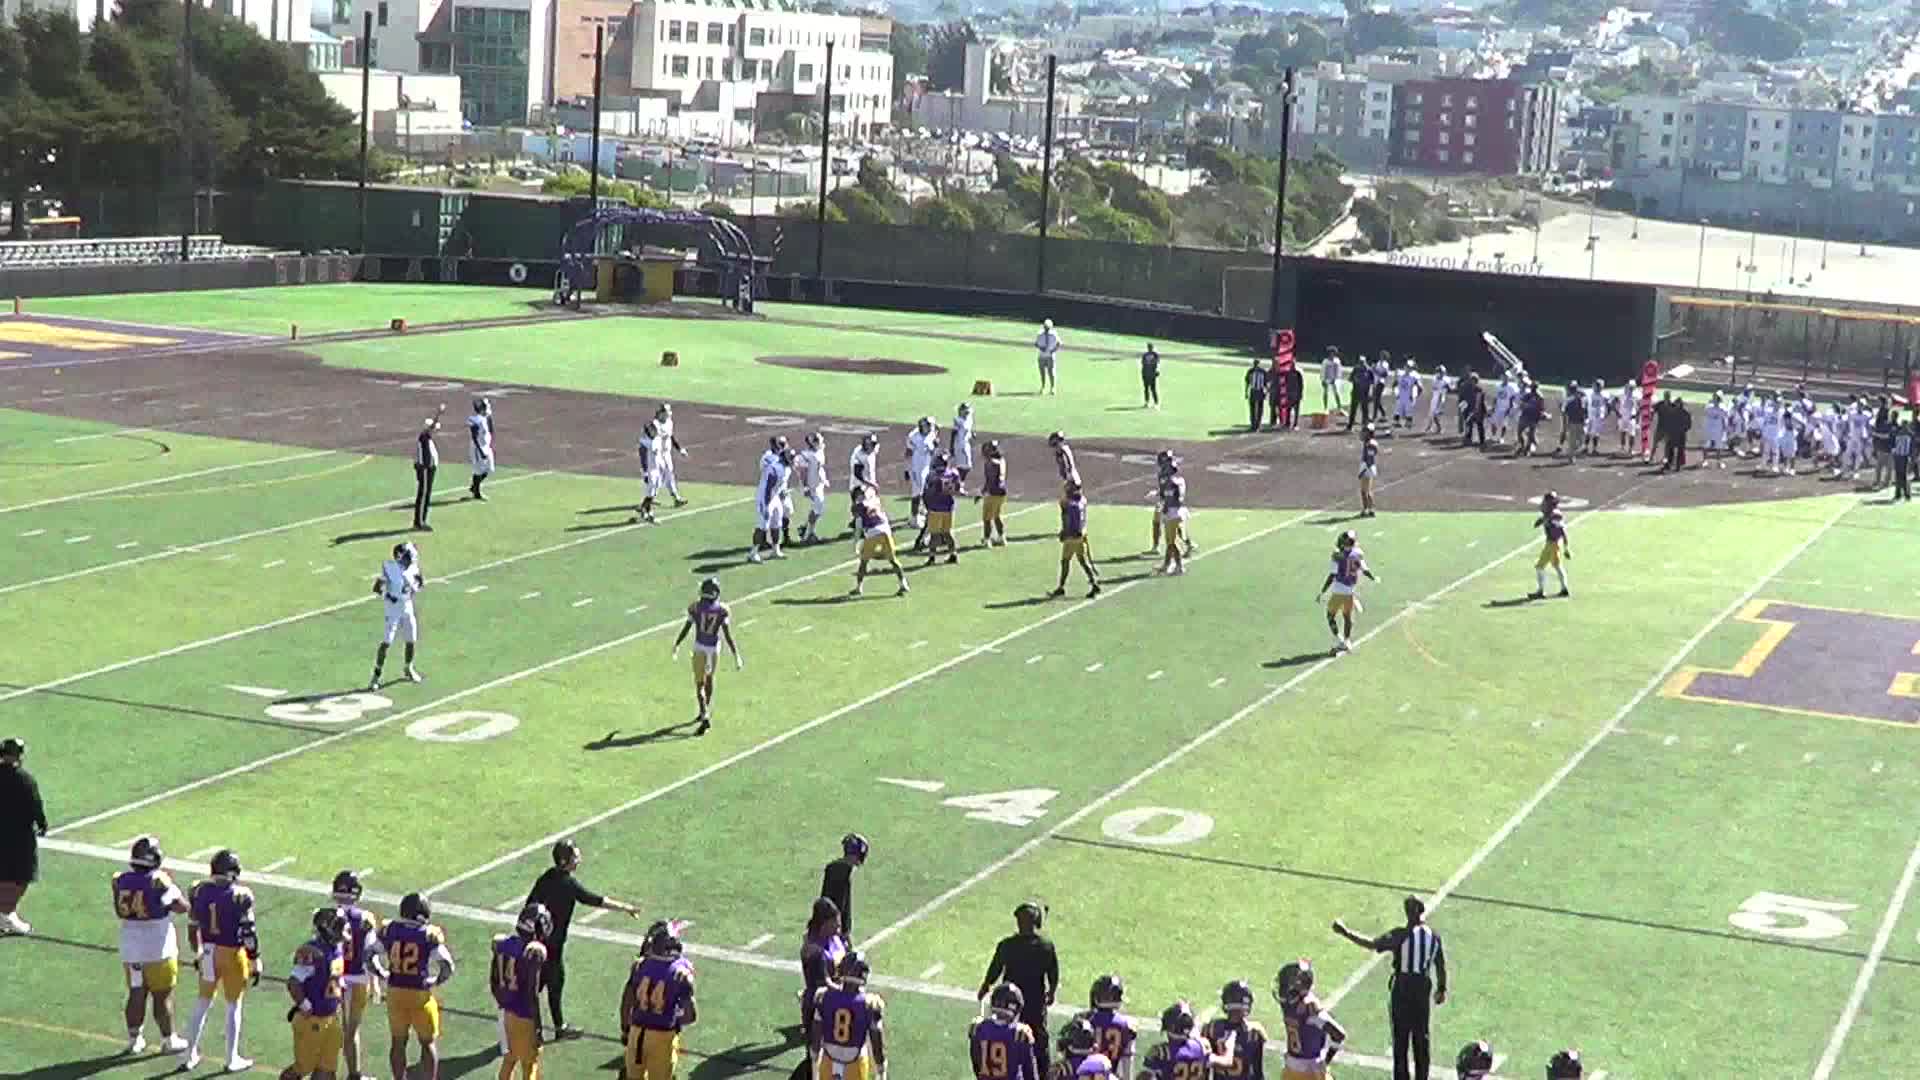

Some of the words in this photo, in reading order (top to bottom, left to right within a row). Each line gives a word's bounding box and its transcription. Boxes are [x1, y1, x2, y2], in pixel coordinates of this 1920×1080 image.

[1386, 252, 1422, 268] RON
[1425, 256, 1470, 271] ISOLA
[1475, 260, 1544, 276] DUGOUT
[701, 611, 719, 634] 17
[119, 889, 150, 919] 54
[208, 902, 221, 936] 1
[390, 940, 420, 976] 42
[499, 952, 520, 991] 14
[636, 975, 666, 1015] 44
[833, 1007, 851, 1043] 8
[980, 1038, 1009, 1078] 19
